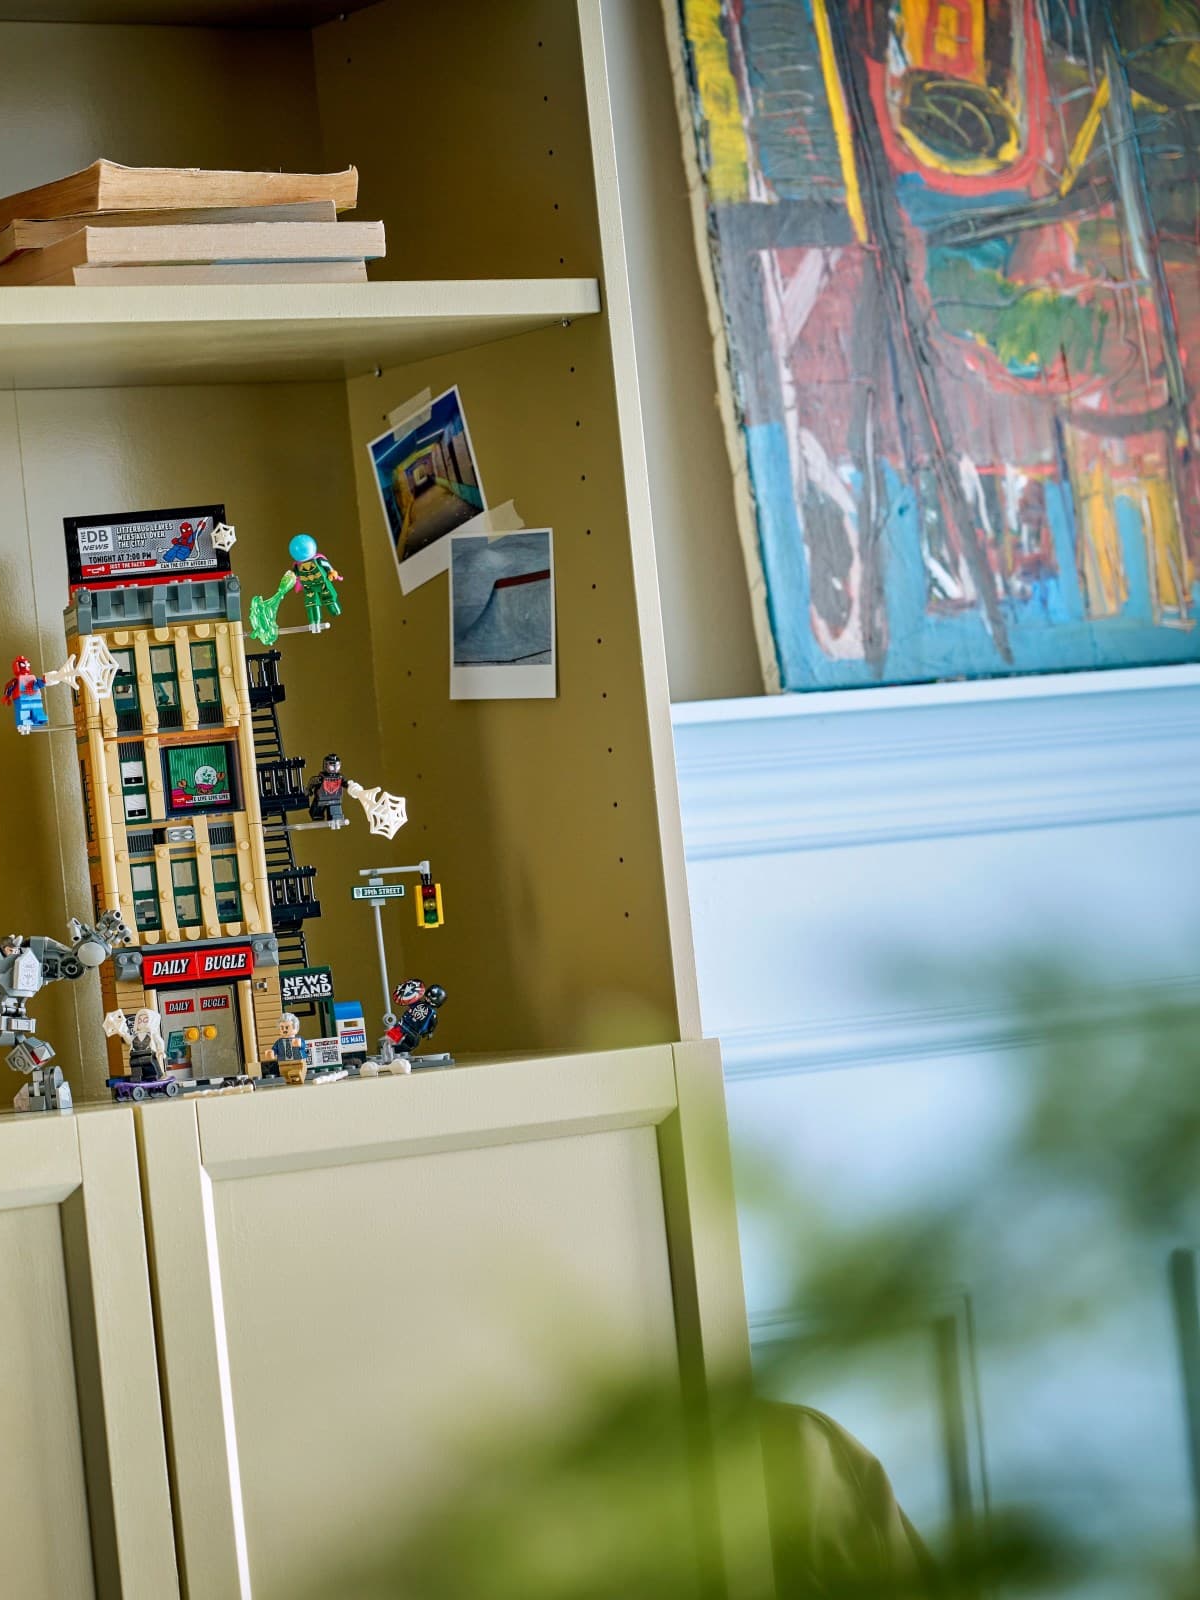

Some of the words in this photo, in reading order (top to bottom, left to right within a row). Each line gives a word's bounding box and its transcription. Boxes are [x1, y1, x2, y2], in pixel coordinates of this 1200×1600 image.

[87, 530, 108, 543] DB
[150, 530, 165, 539] OVER
[82, 543, 109, 551] NEWS
[118, 541, 130, 549] THE
[89, 554, 116, 564] TONIGHT
[118, 554, 125, 562] AT
[126, 553, 139, 561] 7:00
[142, 552, 152, 560] PM
[378, 887, 401, 895] STREET
[152, 959, 189, 977] DAILY
[204, 953, 246, 972] BUGLE
[284, 973, 329, 988] NEWS
[282, 983, 332, 997] STAND
[168, 1001, 190, 1012] DAILY
[202, 997, 227, 1009] BUGLE
[341, 1036, 350, 1044] US
[350, 1035, 364, 1043] MAIL
